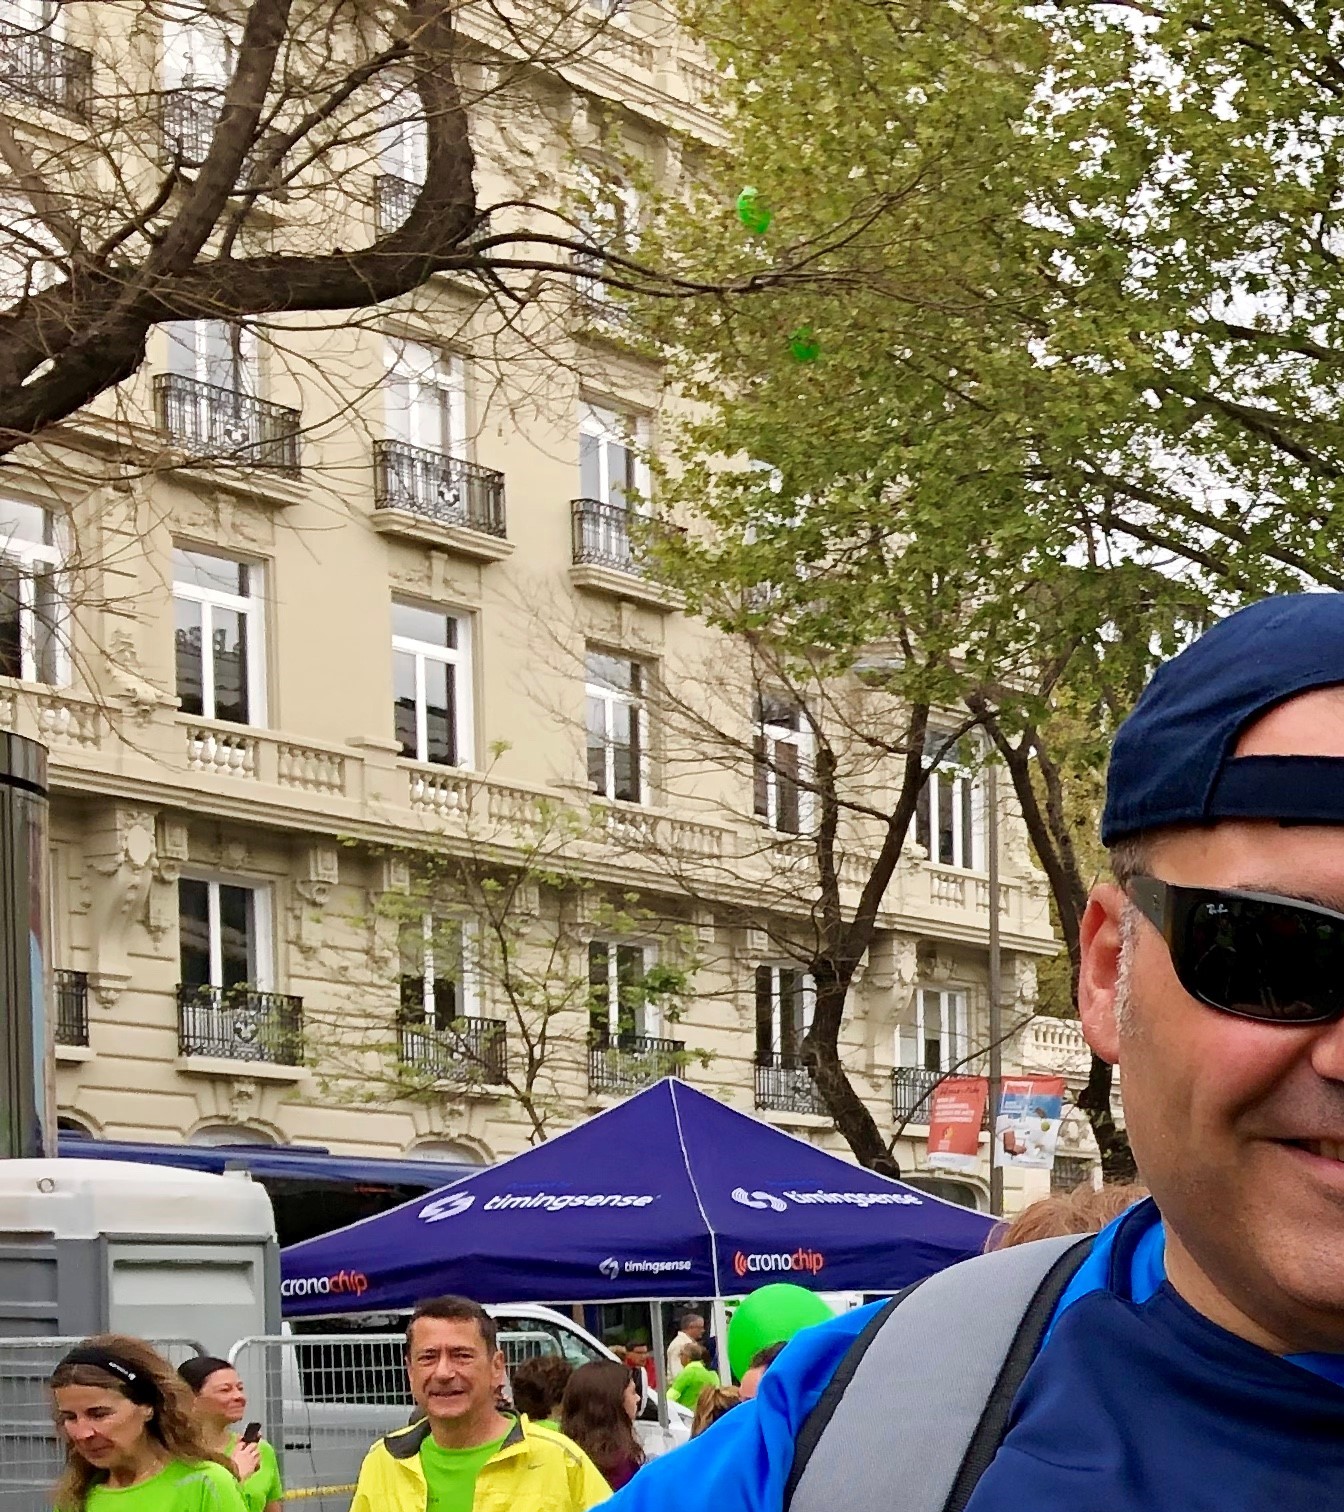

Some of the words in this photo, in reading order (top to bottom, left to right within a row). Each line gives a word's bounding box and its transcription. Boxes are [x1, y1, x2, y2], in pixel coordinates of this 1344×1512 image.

[482, 1191, 654, 1212] timingsense
[782, 1190, 923, 1208] timingsense
[624, 1258, 691, 1274] timingsense
[746, 1247, 824, 1277] cronochip
[280, 1269, 368, 1298] cronochip
